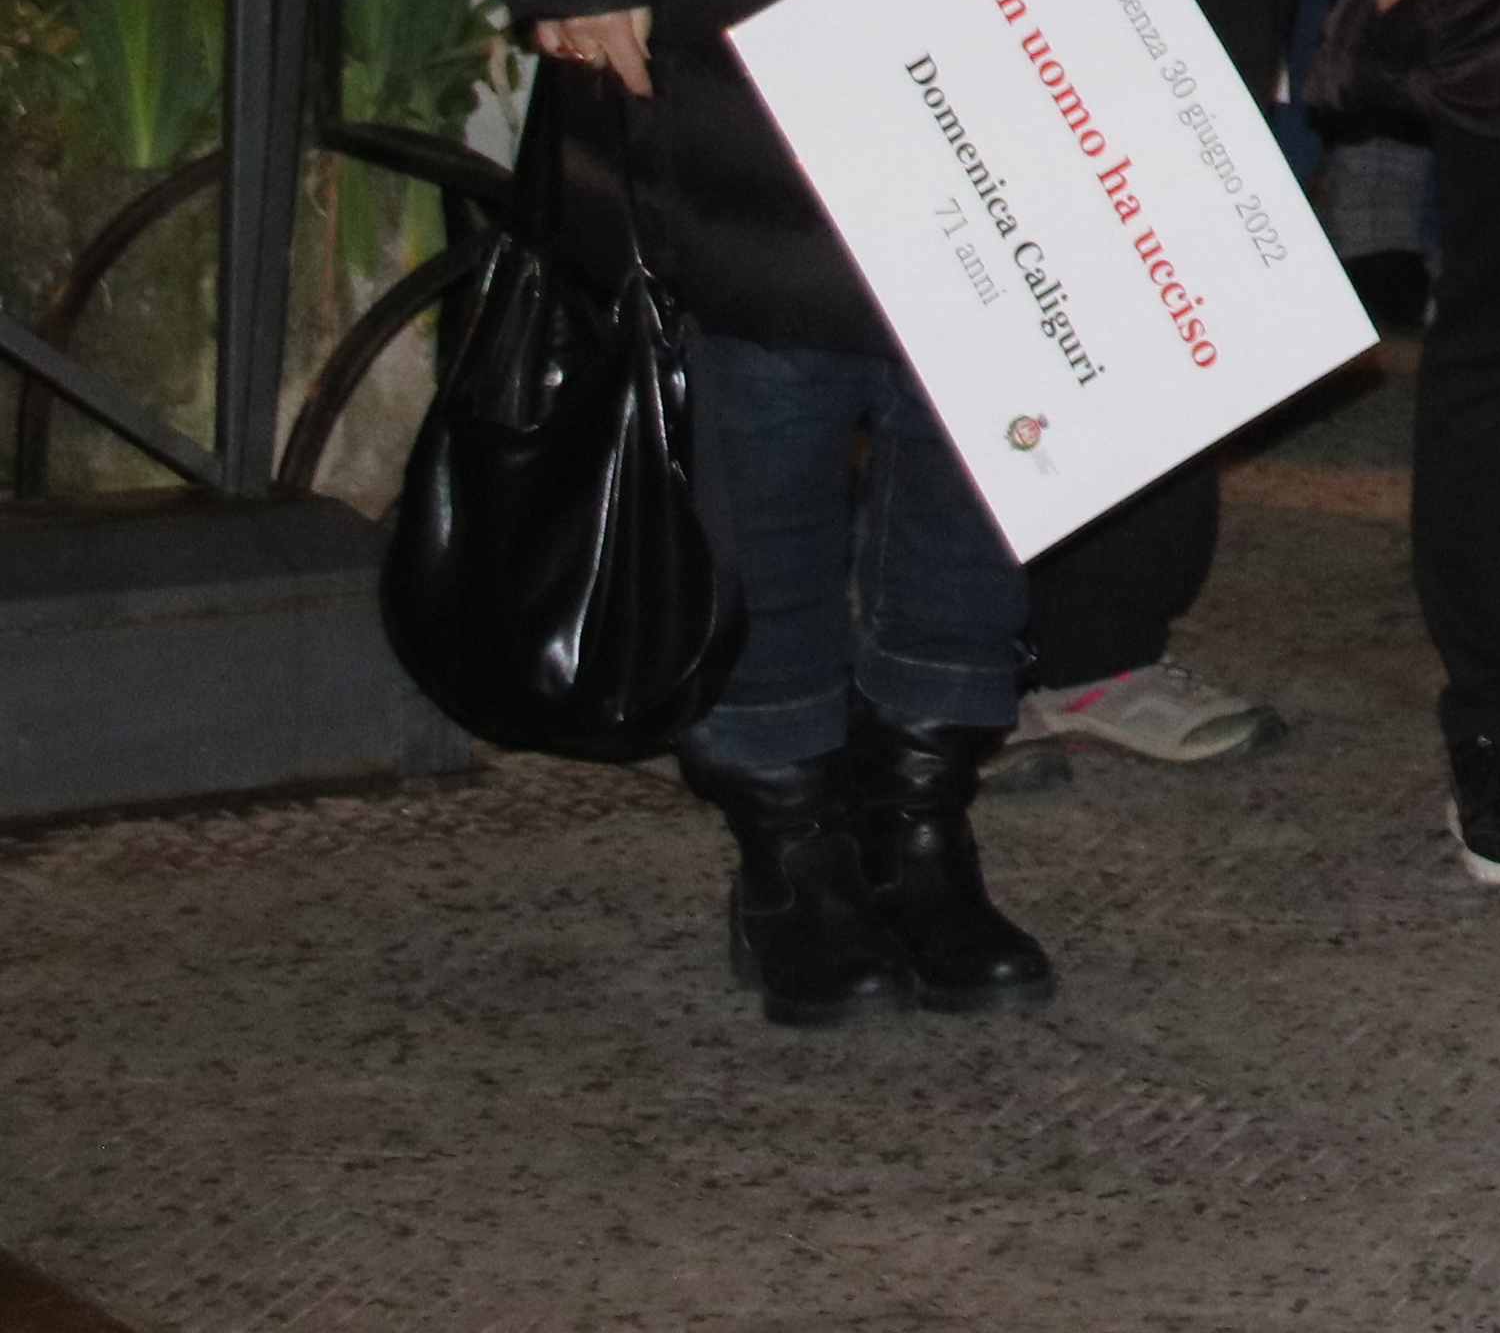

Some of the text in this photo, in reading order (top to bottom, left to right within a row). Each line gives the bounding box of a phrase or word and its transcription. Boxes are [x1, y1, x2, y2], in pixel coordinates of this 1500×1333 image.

[1161, 59, 1196, 100] 30
[1020, 27, 1107, 158] uomo
[1097, 156, 1142, 226] ha
[1133, 227, 1218, 370] ucciso
[1177, 102, 1242, 195] giugno
[905, 52, 1106, 388] Domenica Caliguri
[934, 197, 1004, 307] 71 anni
[1234, 194, 1288, 268] 2022
